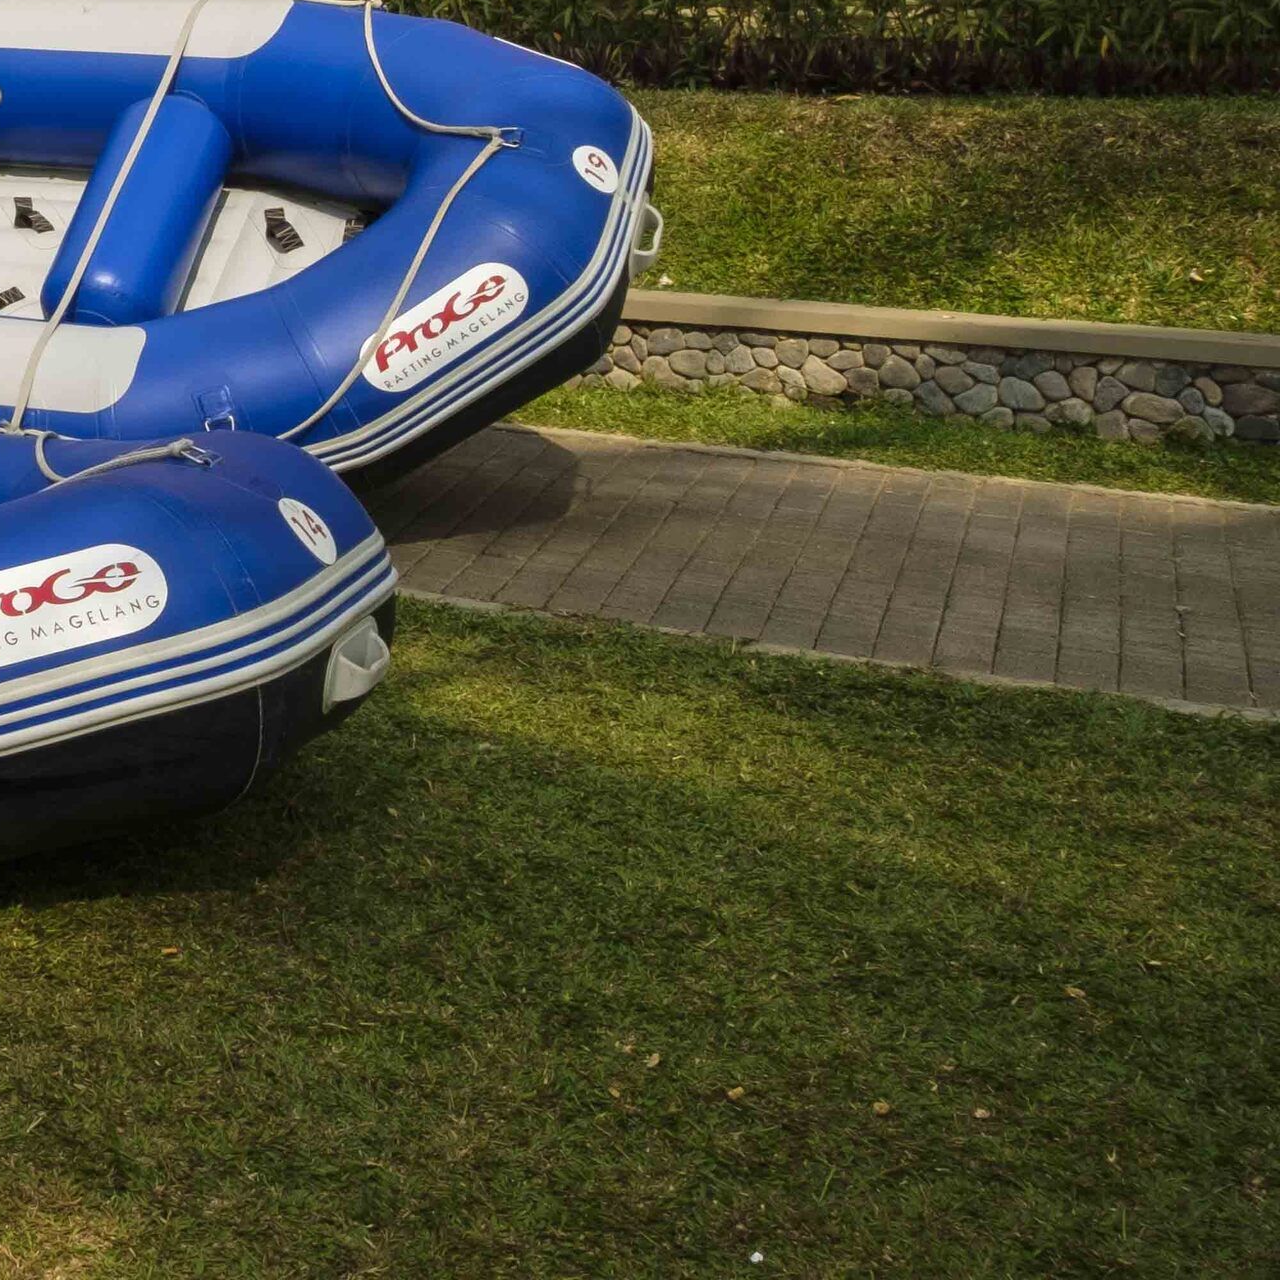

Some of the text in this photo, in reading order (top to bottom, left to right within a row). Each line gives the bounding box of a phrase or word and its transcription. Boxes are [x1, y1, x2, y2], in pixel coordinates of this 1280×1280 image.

[584, 152, 608, 183] 19
[375, 274, 507, 374] ProGo
[383, 291, 526, 390] RAFTING MAGELANG
[291, 510, 327, 546] 14
[31, 594, 161, 640] MAGELANG
